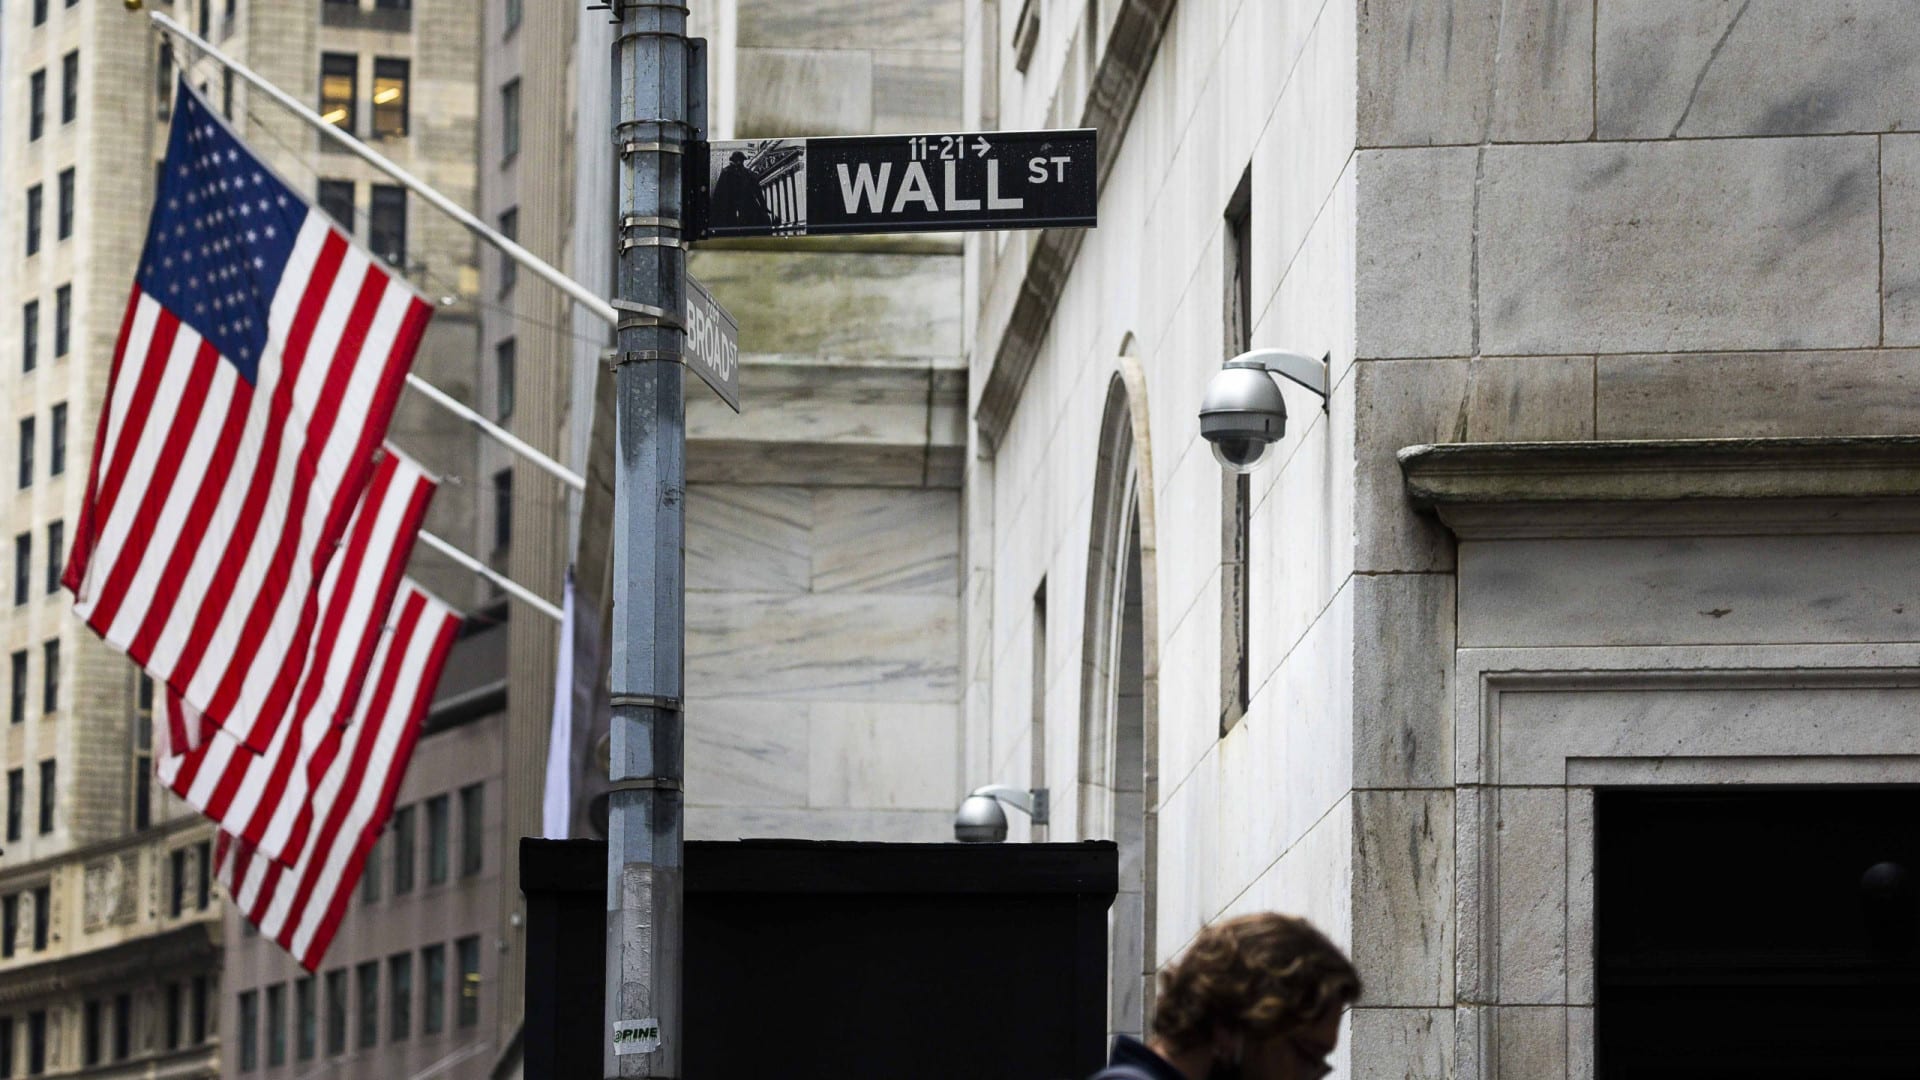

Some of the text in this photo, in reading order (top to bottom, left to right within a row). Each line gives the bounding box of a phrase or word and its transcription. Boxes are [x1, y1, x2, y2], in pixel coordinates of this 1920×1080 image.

[909, 136, 964, 160] 11-21
[837, 156, 1071, 214] WALL ST
[687, 298, 730, 382] BROAD
[729, 341, 738, 369] ST
